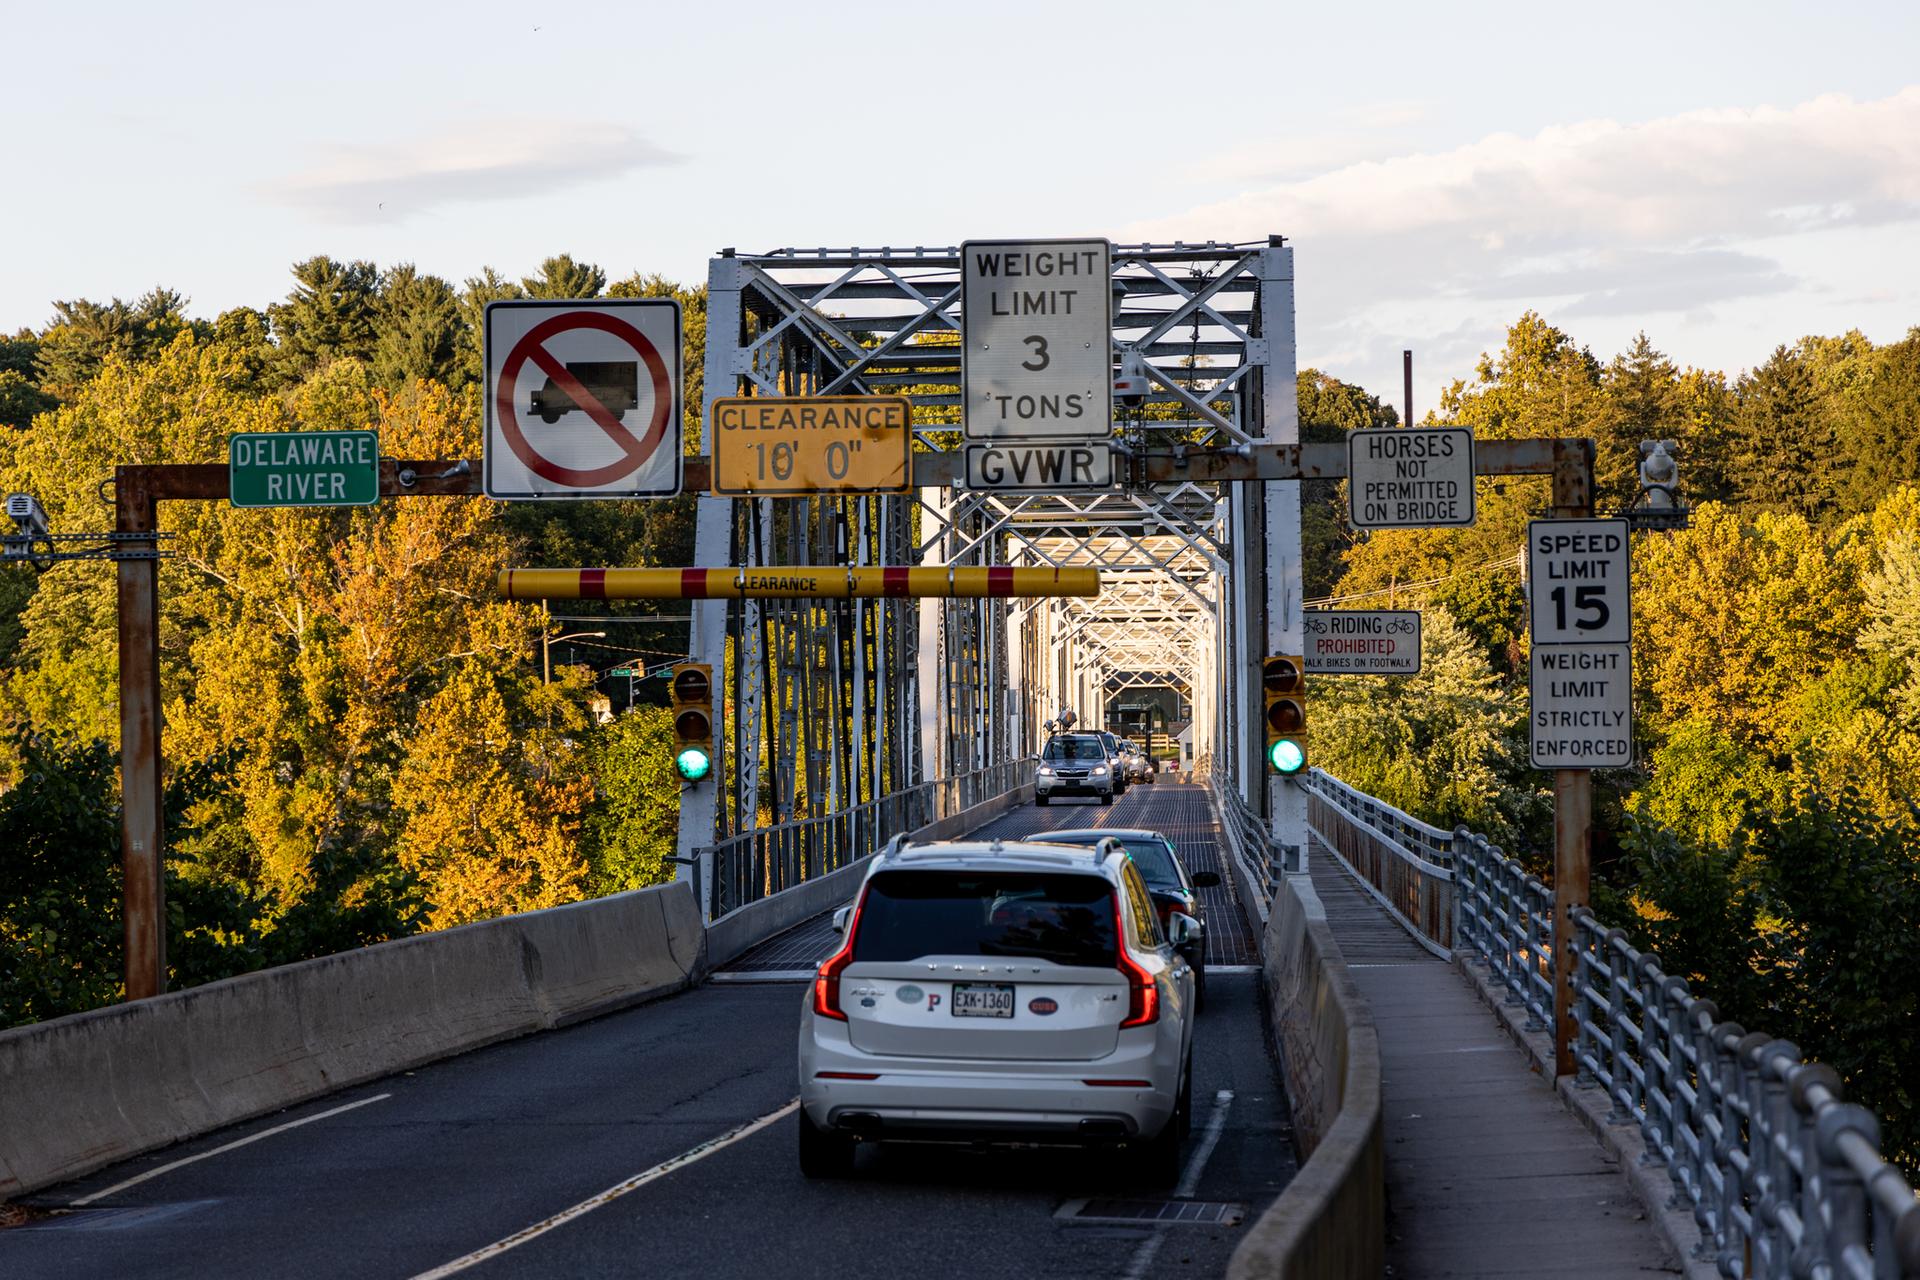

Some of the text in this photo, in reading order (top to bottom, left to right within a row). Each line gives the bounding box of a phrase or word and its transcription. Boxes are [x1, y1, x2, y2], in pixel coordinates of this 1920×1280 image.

[976, 251, 1099, 278] WEIGHT
[991, 290, 1077, 316] LIMIT
[1021, 335, 1050, 371] 3
[995, 394, 1084, 419] TONS
[722, 407, 900, 430] CLEARANCE
[236, 437, 372, 466] DELAWARE
[1369, 435, 1453, 458] HORSES
[980, 449, 1095, 485] GVWR
[1396, 460, 1427, 478] NOT
[267, 472, 346, 500] RIVER
[1365, 481, 1457, 500] PERMITTED
[1365, 501, 1458, 521] ON BRIDGE
[1538, 534, 1621, 554] SPEED
[1548, 560, 1611, 579] LIMIT
[733, 576, 817, 591] CLEARANCE
[1550, 585, 1610, 631] 15
[1331, 617, 1382, 634] RIDING
[1317, 639, 1396, 655] PROHIBITED
[1326, 659, 1351, 668] BIKES
[1354, 659, 1366, 668] ON
[1370, 658, 1411, 668] FOOTWALK
[1541, 654, 1619, 670] WEIGHT
[1551, 681, 1609, 698] LIMIT
[1537, 711, 1624, 727] STRICTLY
[1536, 739, 1628, 756] ENFORCED
